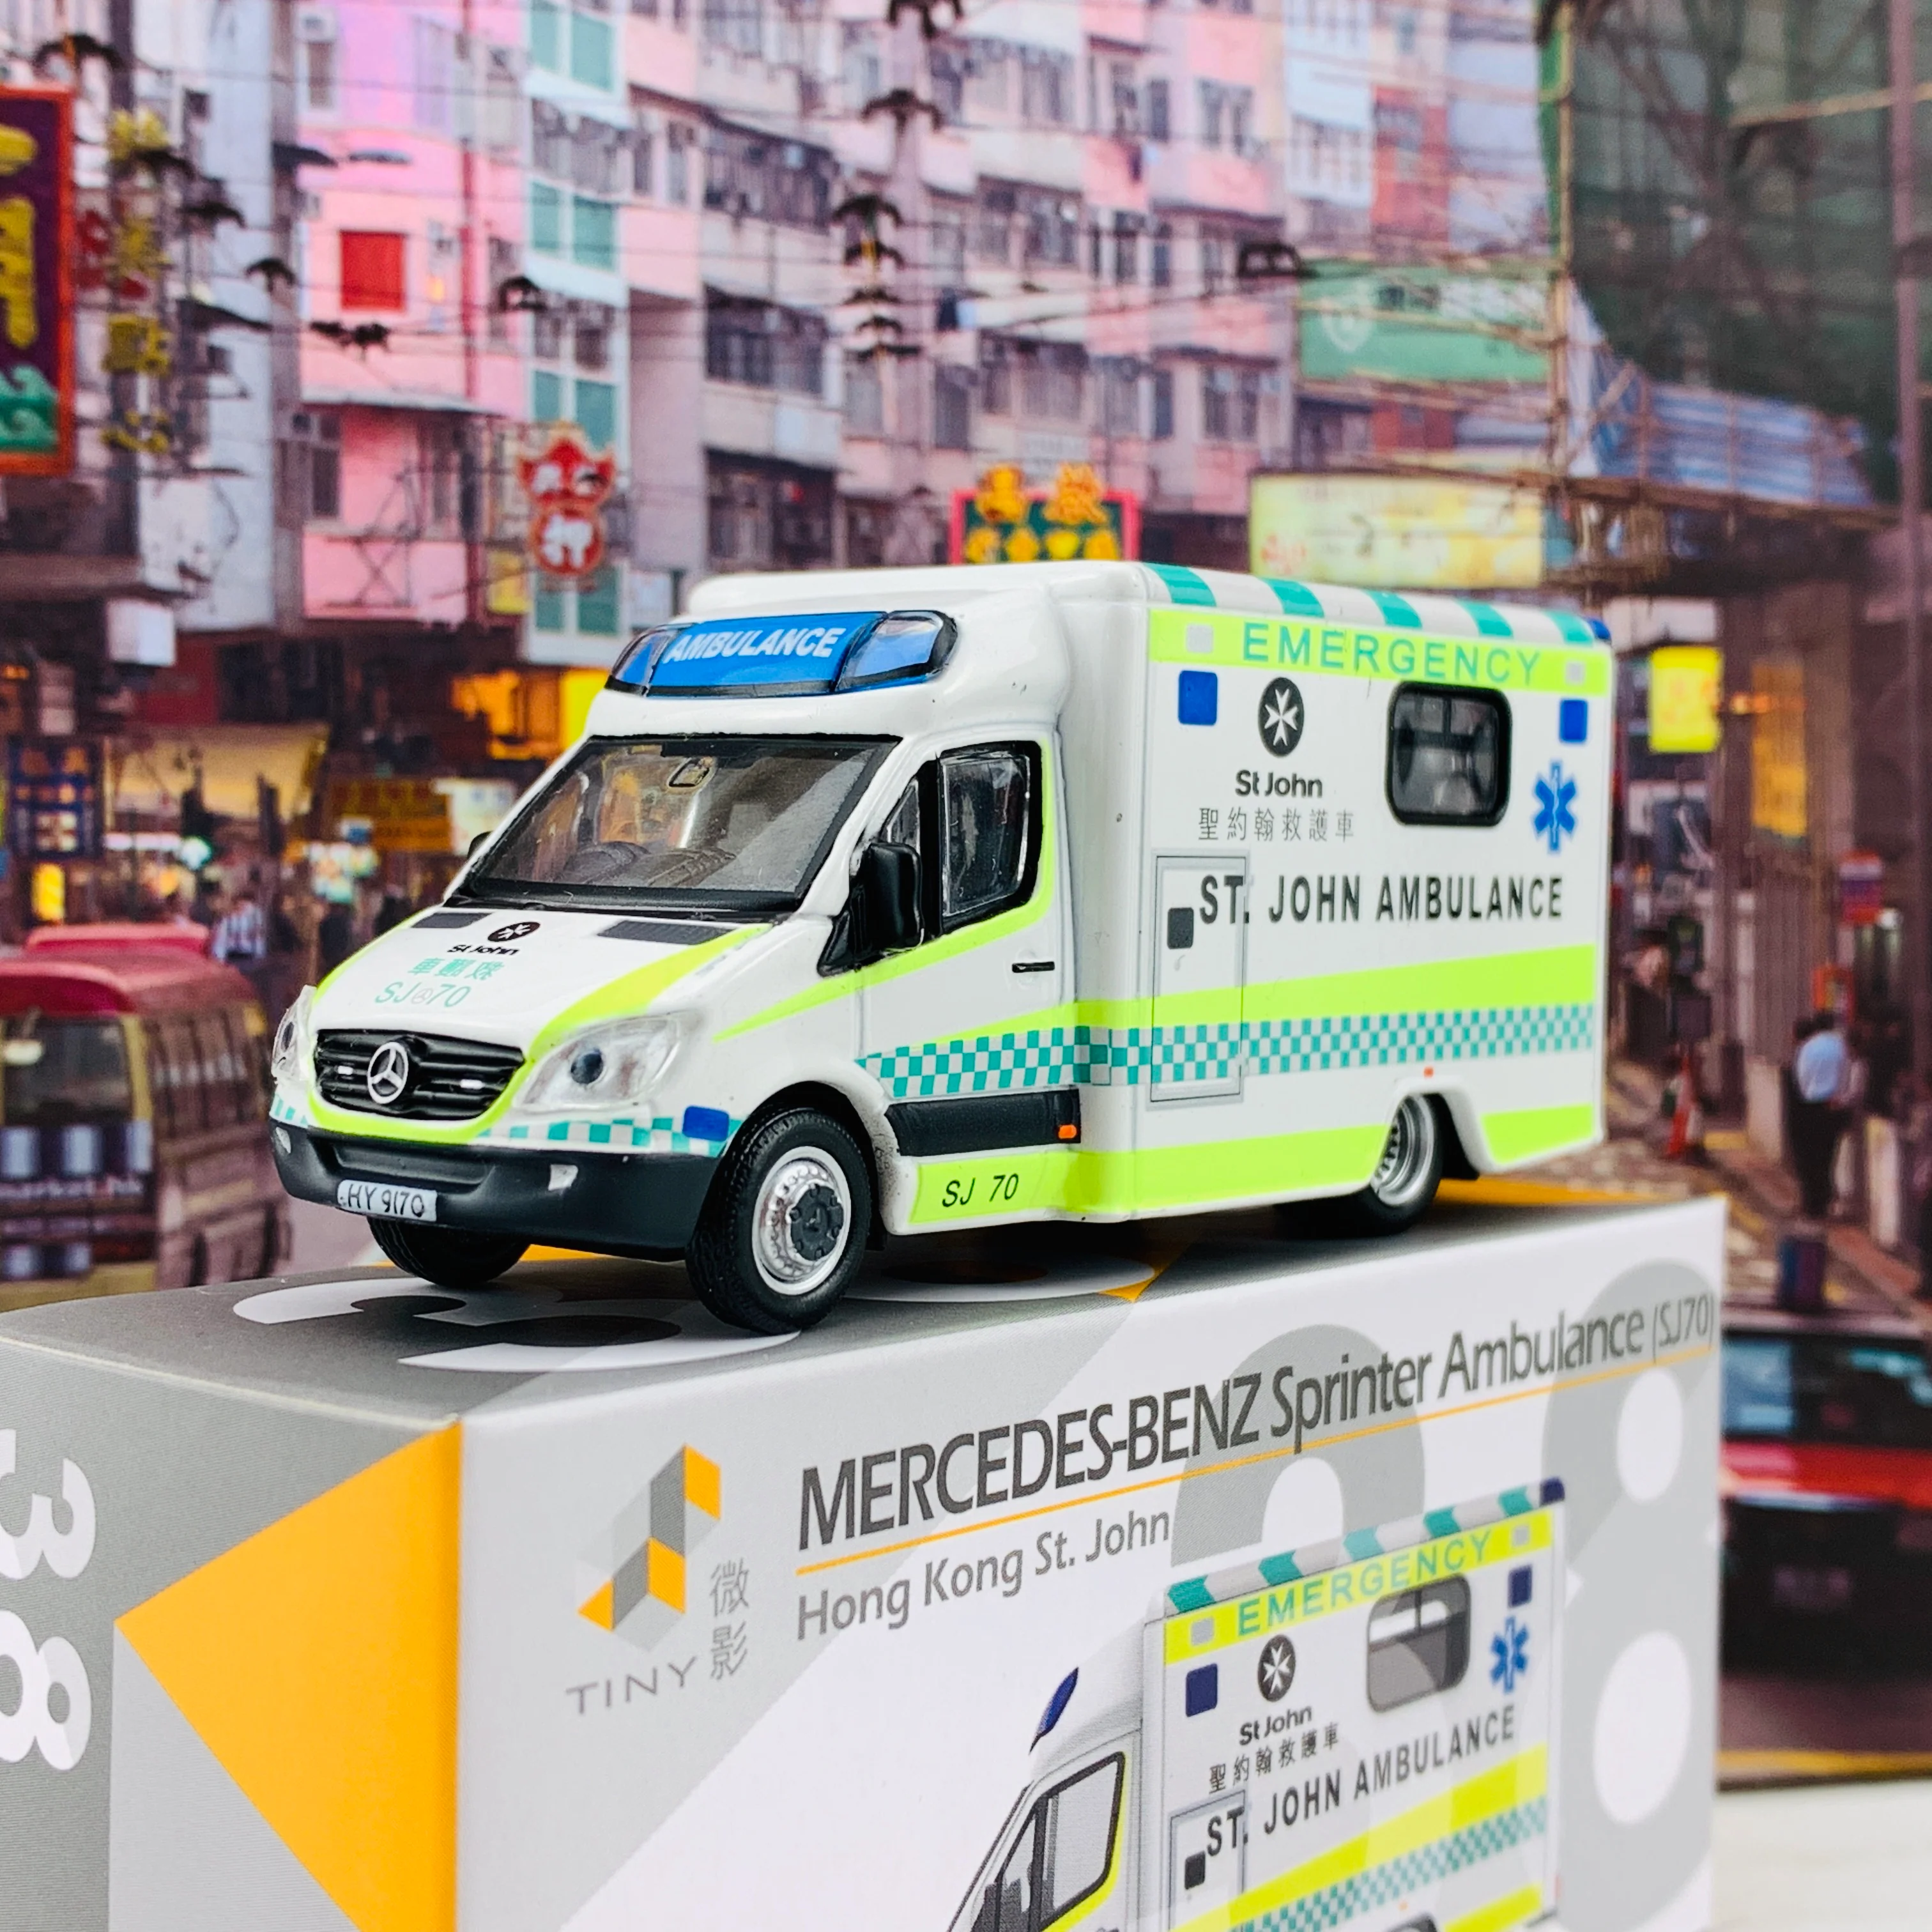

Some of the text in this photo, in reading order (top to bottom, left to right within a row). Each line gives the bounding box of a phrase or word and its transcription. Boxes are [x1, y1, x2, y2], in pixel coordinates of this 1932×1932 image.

[663, 626, 847, 664] AMBULANCE
[1243, 621, 1541, 686] EMERGENCY
[1234, 770, 1322, 799] St John
[1198, 806, 1354, 843] 聖約翰救護車
[1199, 874, 1563, 925] ST. JOHN AMBULANCE
[447, 944, 520, 956] St John
[375, 981, 471, 1008] SJ 70
[347, 1183, 425, 1218] HY 9170
[942, 1173, 1019, 1208] SJ 70
[798, 1291, 1715, 1552] MERCEDES-BENZ Sprinter Ambulance (SJ70)
[797, 1510, 1169, 1641] Hong Kong St. John
[1237, 1531, 1494, 1637] EMERGENCY
[709, 1557, 750, 1682] 微影
[566, 1655, 698, 1715] TINY
[1239, 1705, 1312, 1746] St John
[1207, 1705, 1515, 1857] ST. JOHN AMBULANCE
[1209, 1721, 1340, 1795] 聖約翰救護車
